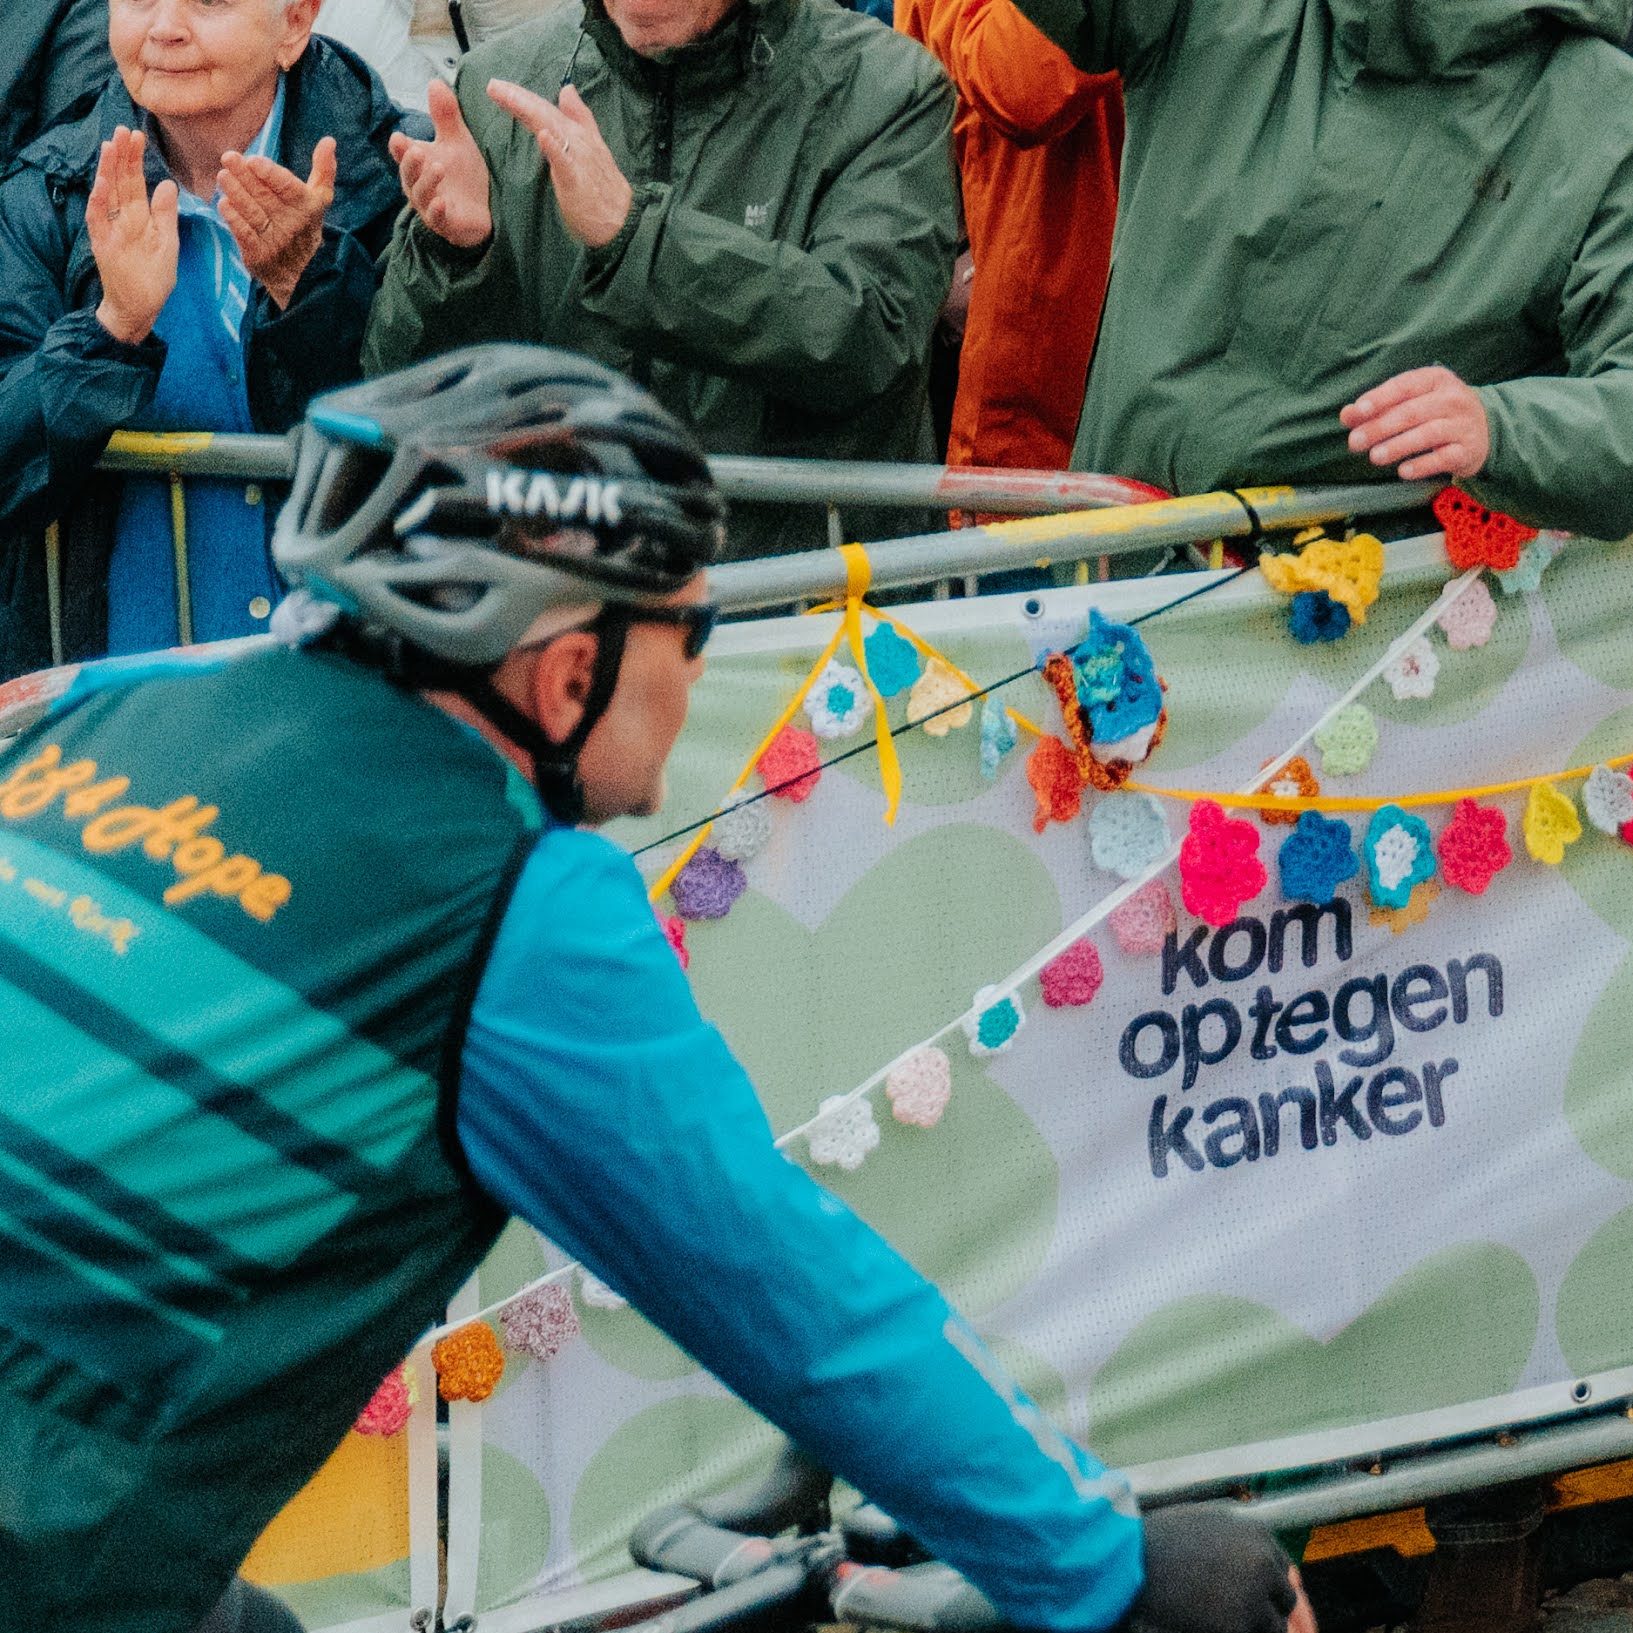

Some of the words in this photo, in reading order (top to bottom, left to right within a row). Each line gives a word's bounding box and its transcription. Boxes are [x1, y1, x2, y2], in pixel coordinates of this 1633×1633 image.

[1162, 897, 1353, 995] kom
[1118, 998, 1241, 1091] op
[1249, 953, 1504, 1068] tegen
[1148, 1058, 1459, 1178] kanker
